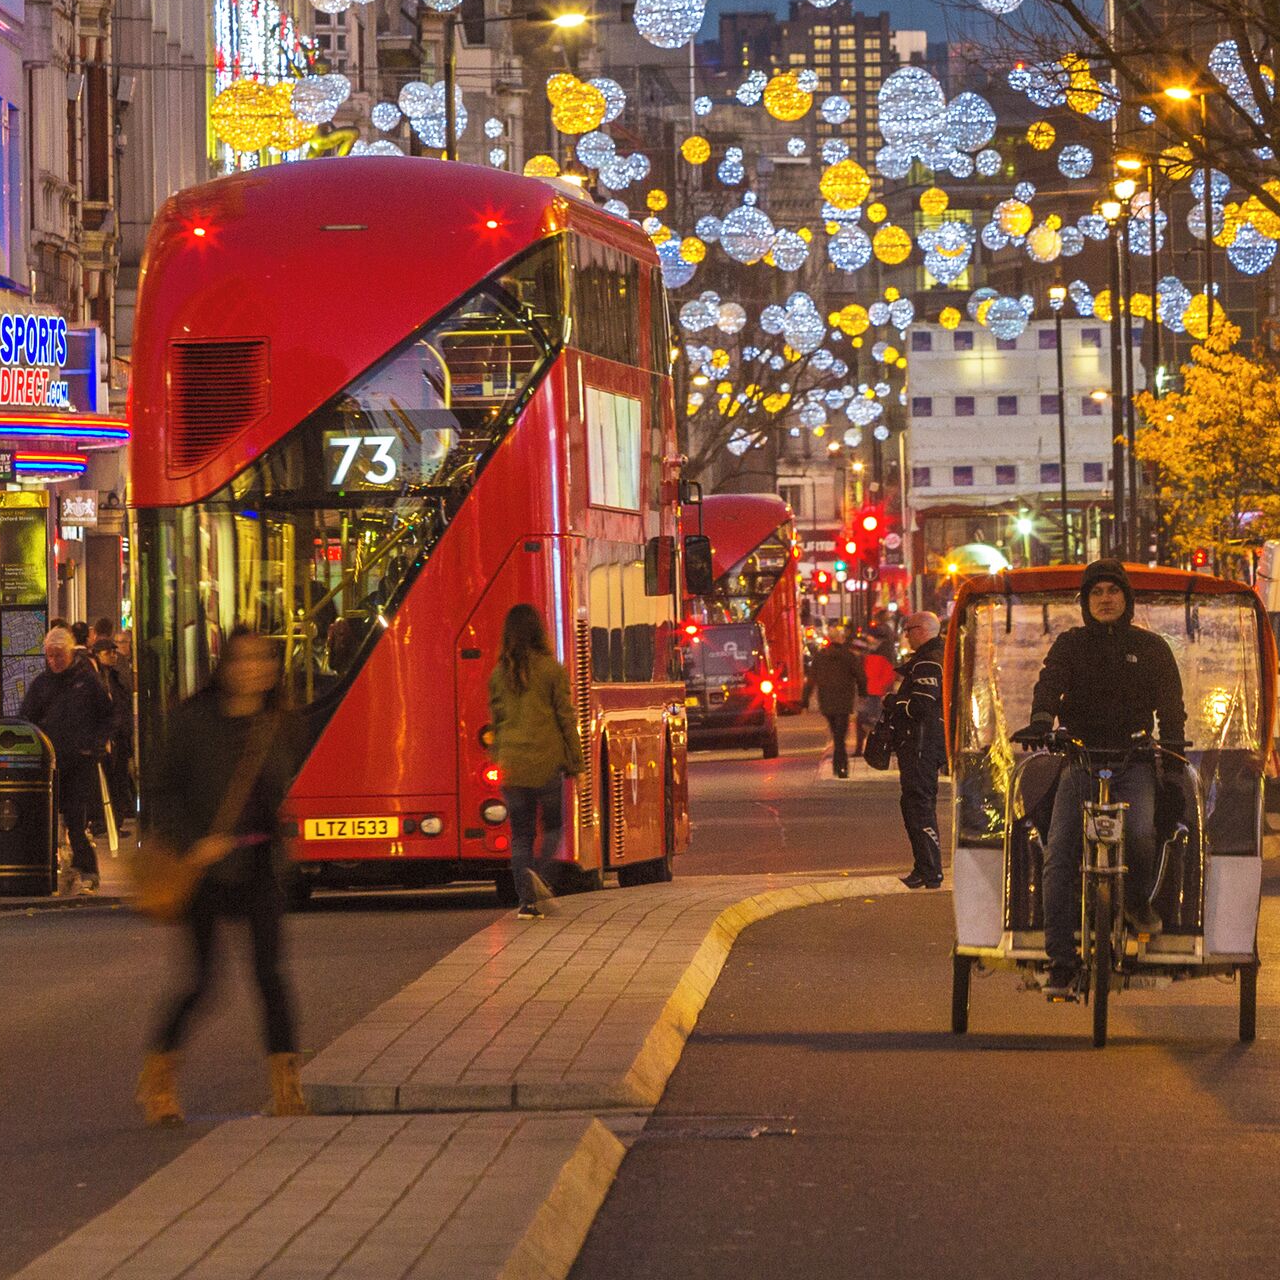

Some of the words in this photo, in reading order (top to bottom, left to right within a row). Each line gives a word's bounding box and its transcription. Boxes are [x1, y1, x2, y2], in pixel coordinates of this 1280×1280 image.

[0, 314, 67, 366] SPORTS
[329, 436, 397, 485] 73
[316, 822, 346, 837] LTZ
[351, 820, 388, 835] 1533
